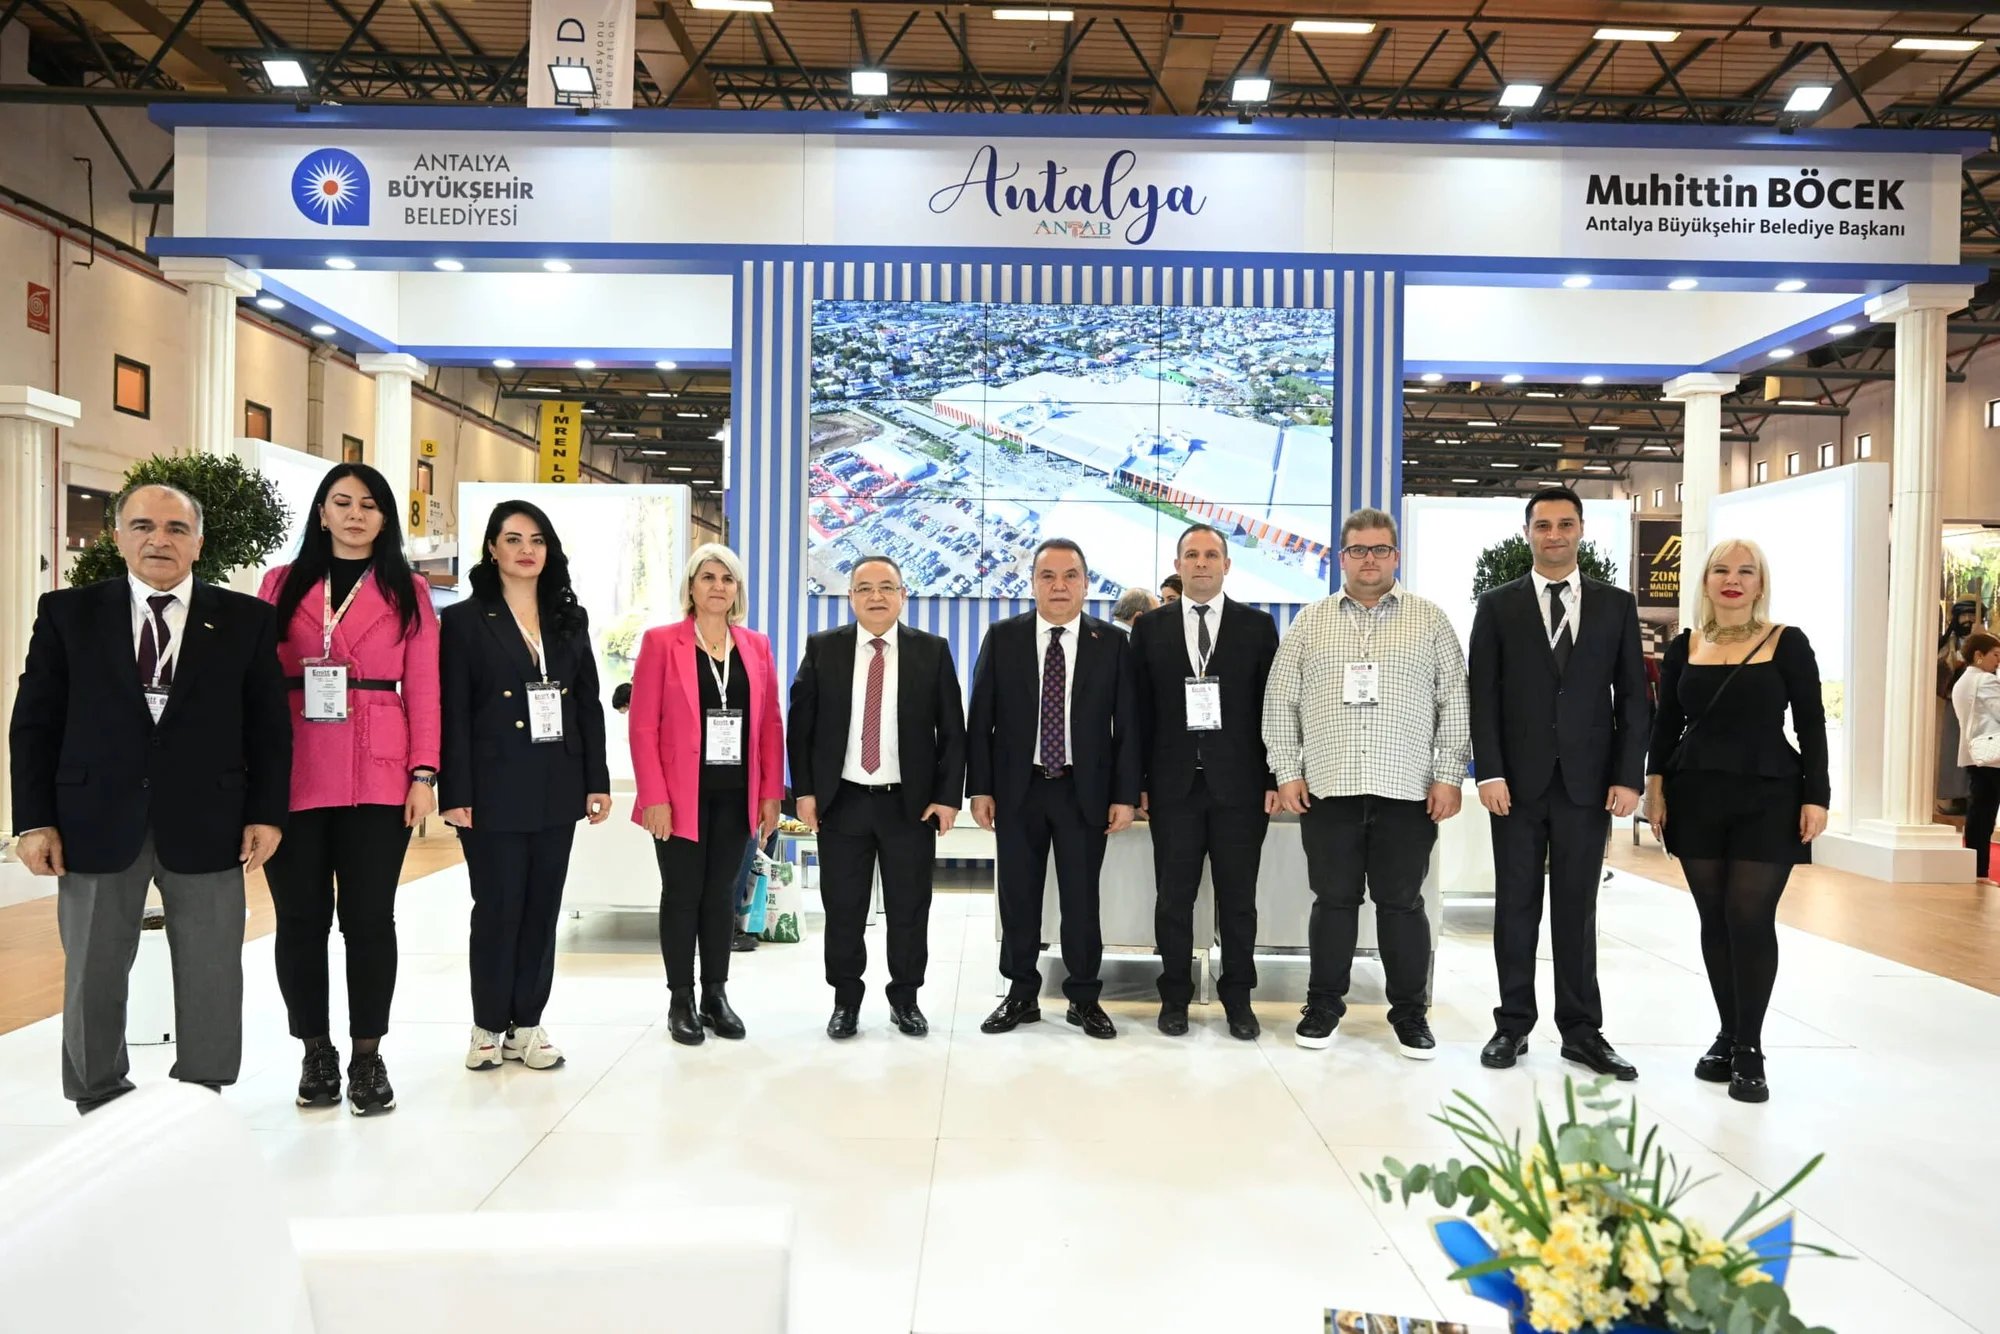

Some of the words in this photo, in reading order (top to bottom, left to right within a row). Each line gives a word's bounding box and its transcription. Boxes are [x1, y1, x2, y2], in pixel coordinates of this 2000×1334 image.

[413, 153, 511, 172] ANTALYA
[388, 175, 534, 203] BÜYÜKŞEHİR
[929, 145, 1207, 245] Antalya
[1586, 173, 1758, 208] Muhittin
[1767, 168, 1906, 211] BÖCEK
[404, 203, 518, 226] BELEDİYESİ
[1585, 216, 1653, 236] Antalya
[1658, 217, 1756, 237] Büyükşehir
[1760, 219, 1835, 239] Belediye
[1839, 220, 1905, 240] Başkanı
[426, 443, 434, 453] 8
[411, 500, 421, 527] 8
[1649, 571, 1681, 582] ZON
[1649, 582, 1679, 591] MADEN
